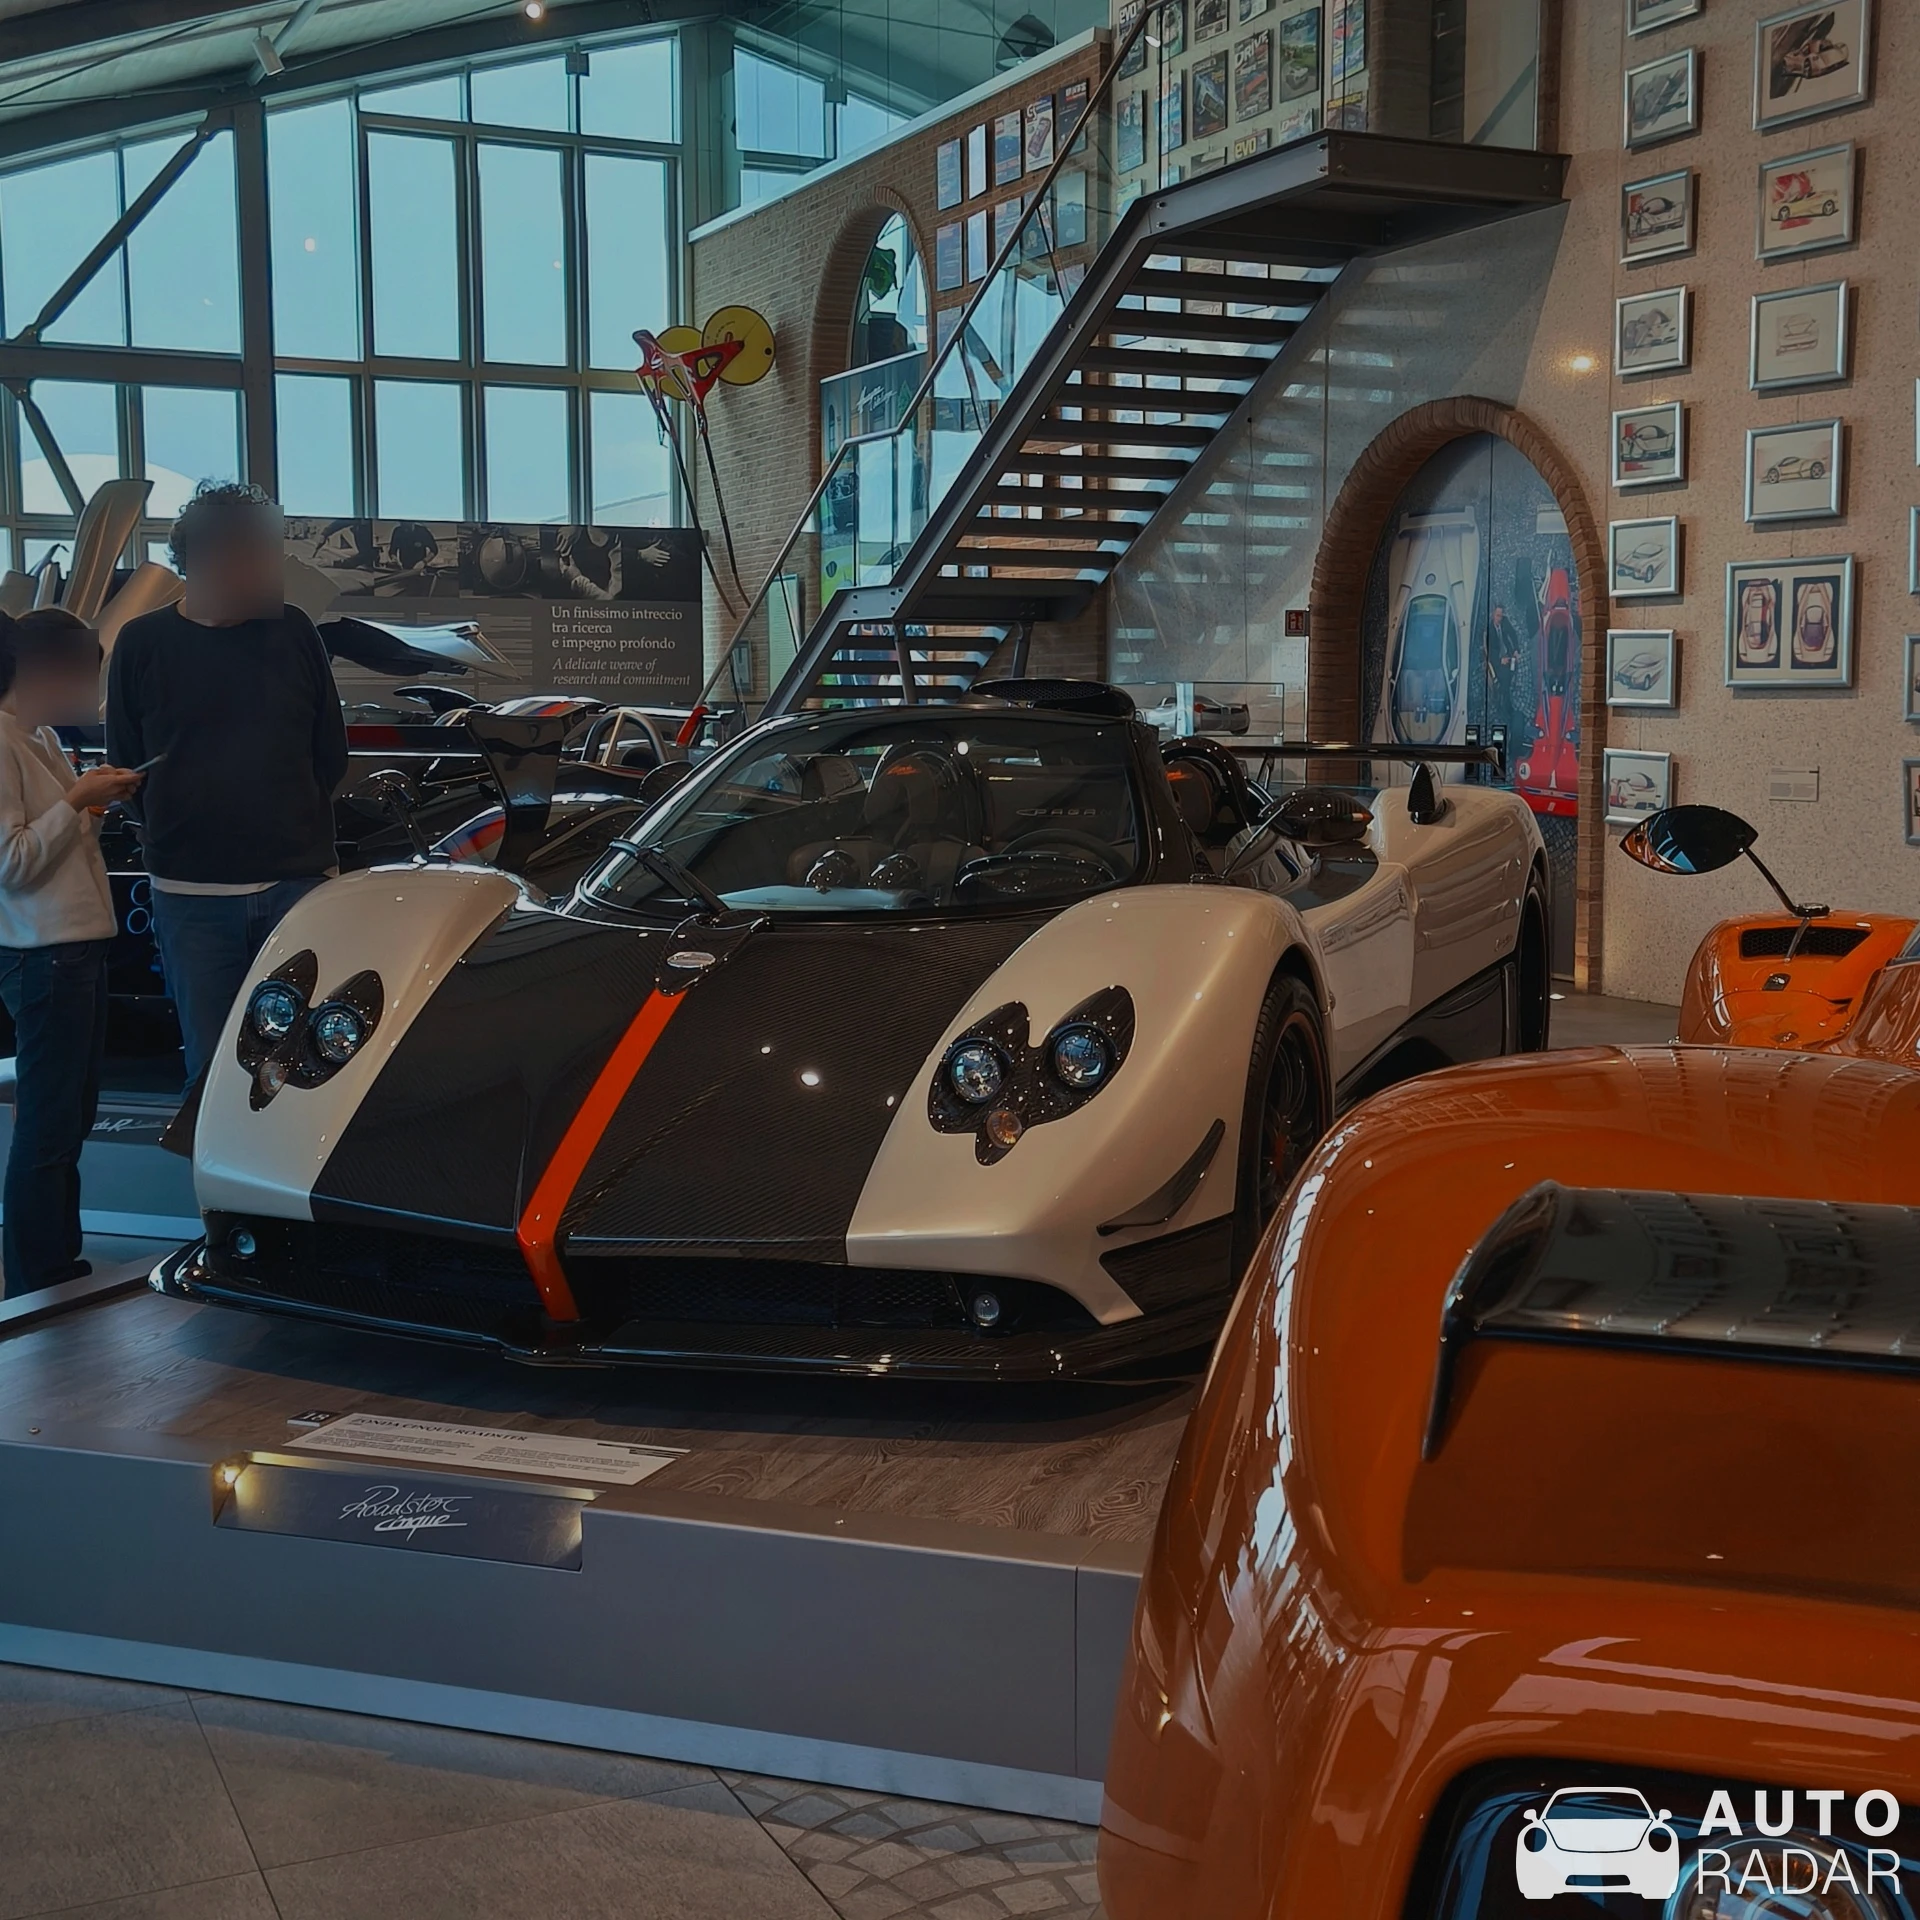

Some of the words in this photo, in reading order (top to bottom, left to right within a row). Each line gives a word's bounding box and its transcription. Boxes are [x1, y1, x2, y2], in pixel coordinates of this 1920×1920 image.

[1119, 2, 1137, 24] evo
[1235, 136, 1257, 160] evo
[551, 606, 570, 618] Un
[573, 606, 629, 619] finissimo
[632, 608, 682, 620] intreccio
[551, 622, 568, 633] tra
[572, 622, 612, 633] ricerca
[551, 638, 559, 648] e
[562, 636, 616, 652] impegno
[620, 636, 675, 652] profondo
[552, 658, 562, 670] A
[565, 657, 606, 670] delicate
[610, 661, 643, 670] weave
[645, 658, 657, 674] of
[552, 673, 597, 684] research
[599, 673, 620, 684] and
[623, 674, 690, 686] commitment
[299, 1412, 330, 1421] 18
[351, 1418, 399, 1427] ZONDA
[402, 1423, 453, 1433] CINQUE
[455, 1429, 529, 1441] ROADSTER
[338, 1484, 473, 1520] Roadster
